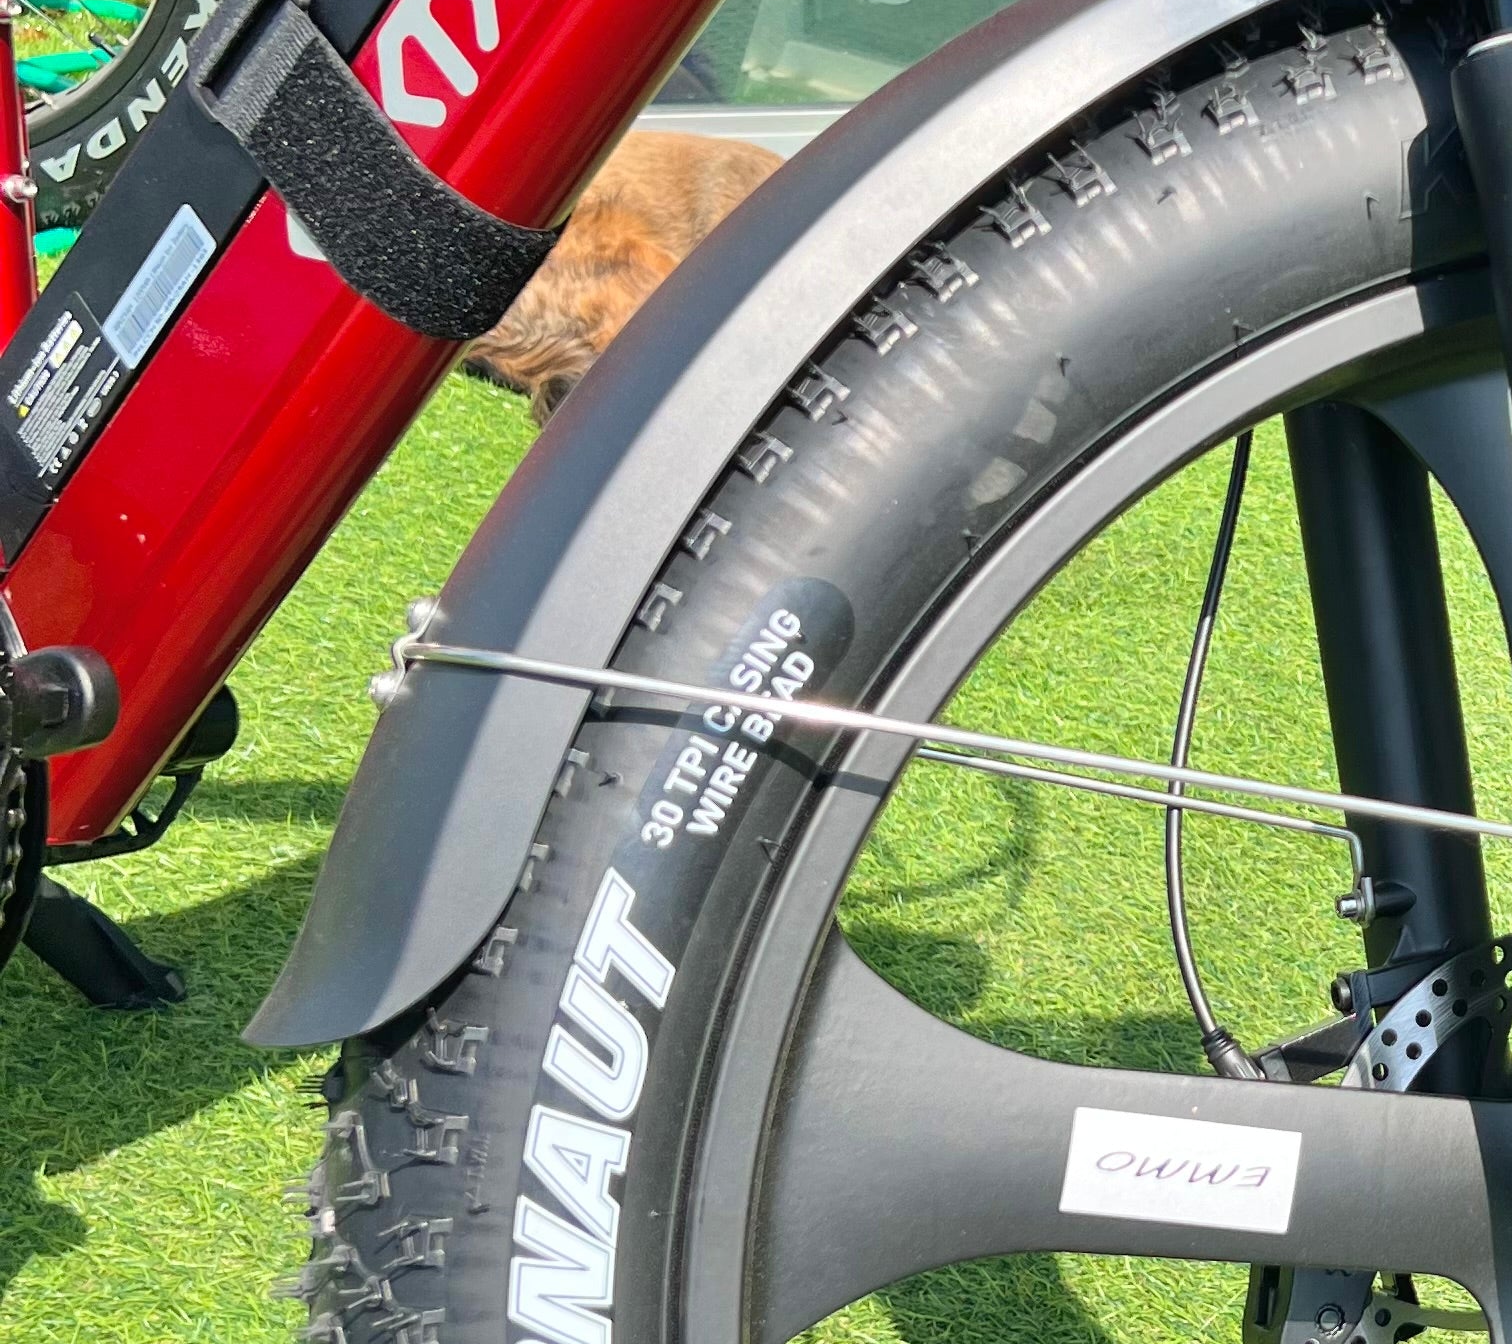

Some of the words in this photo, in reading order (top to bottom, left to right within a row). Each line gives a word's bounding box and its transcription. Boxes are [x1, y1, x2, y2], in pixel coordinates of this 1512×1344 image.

[641, 799, 684, 849] 30
[663, 734, 720, 794] TPI
[686, 740, 758, 837] WIRE
[1096, 1151, 1272, 1188] EMMO
